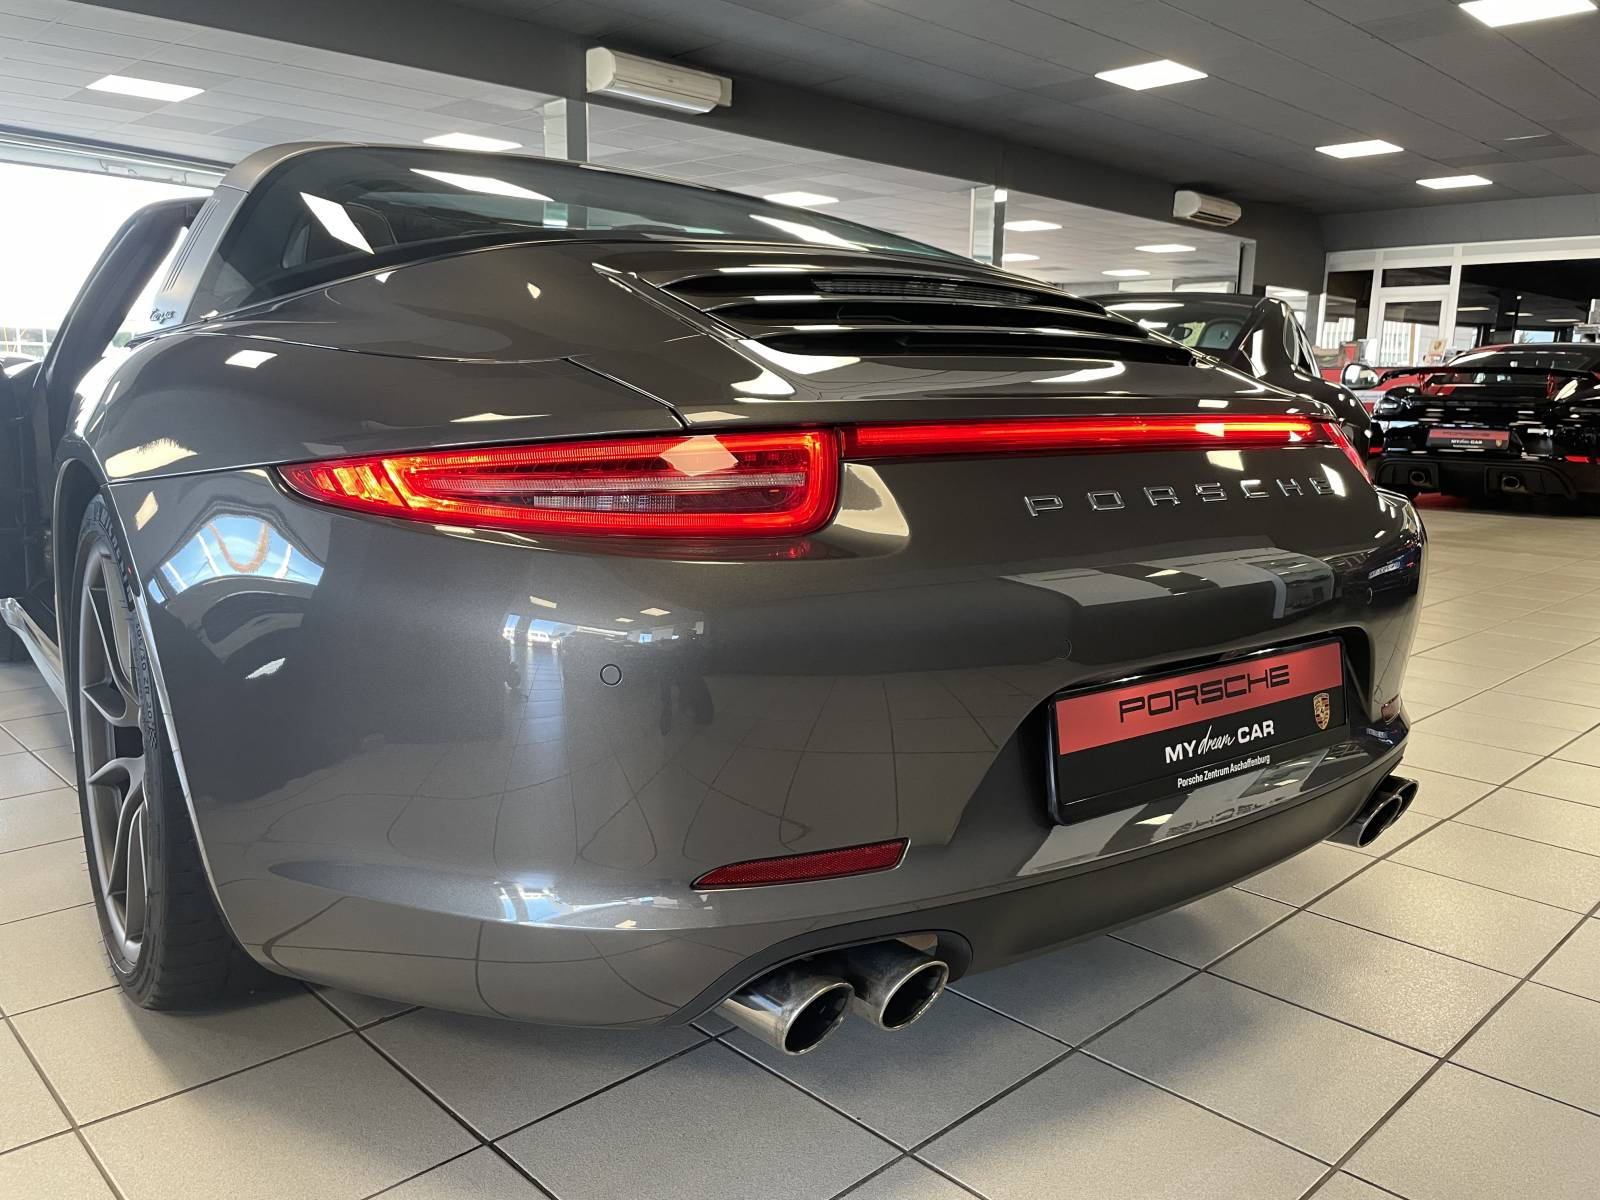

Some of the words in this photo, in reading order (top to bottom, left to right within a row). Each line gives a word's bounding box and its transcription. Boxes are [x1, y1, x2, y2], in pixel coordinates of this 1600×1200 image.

[1024, 477, 1336, 517] PORSCHE
[1119, 664, 1290, 723] PORSCHE
[1164, 739, 1197, 764] MY
[1197, 724, 1236, 755] dream
[1237, 719, 1275, 744] CAR
[1177, 773, 1204, 789] Porsche
[1203, 766, 1230, 781] Zentrum
[1229, 754, 1271, 774] Aschaffenburg
